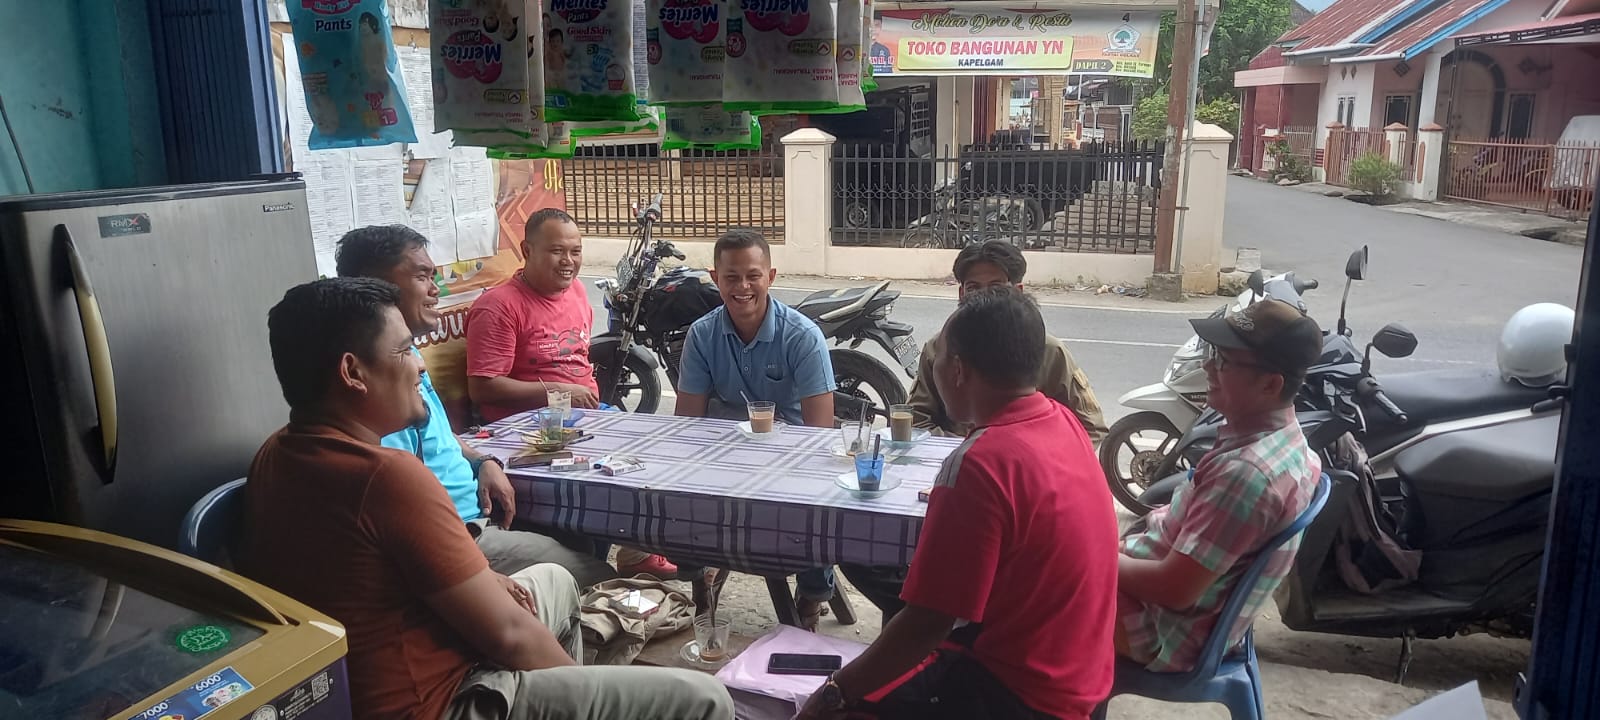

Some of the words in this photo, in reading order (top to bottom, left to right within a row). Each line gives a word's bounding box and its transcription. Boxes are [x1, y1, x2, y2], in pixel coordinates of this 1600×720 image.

[659, 4, 719, 26] Merries
[740, 0, 809, 17] Merries
[566, 11, 590, 23] Pants
[912, 12, 967, 34] Mohon
[1028, 13, 1072, 33] Restu
[1122, 13, 1131, 23] 4
[315, 18, 353, 32] Pants
[567, 26, 589, 35] Good
[456, 29, 482, 43] Pants
[440, 43, 501, 64] Merries
[907, 40, 949, 56] TOKO
[950, 40, 1040, 56] BANGUNAN
[1042, 40, 1063, 55] YN
[958, 58, 1004, 67] KAPELGAM
[1075, 61, 1099, 70] DAPIL
[1100, 61, 1108, 71] 2
[195, 674, 221, 691] 6000
[142, 702, 169, 720] 7000
